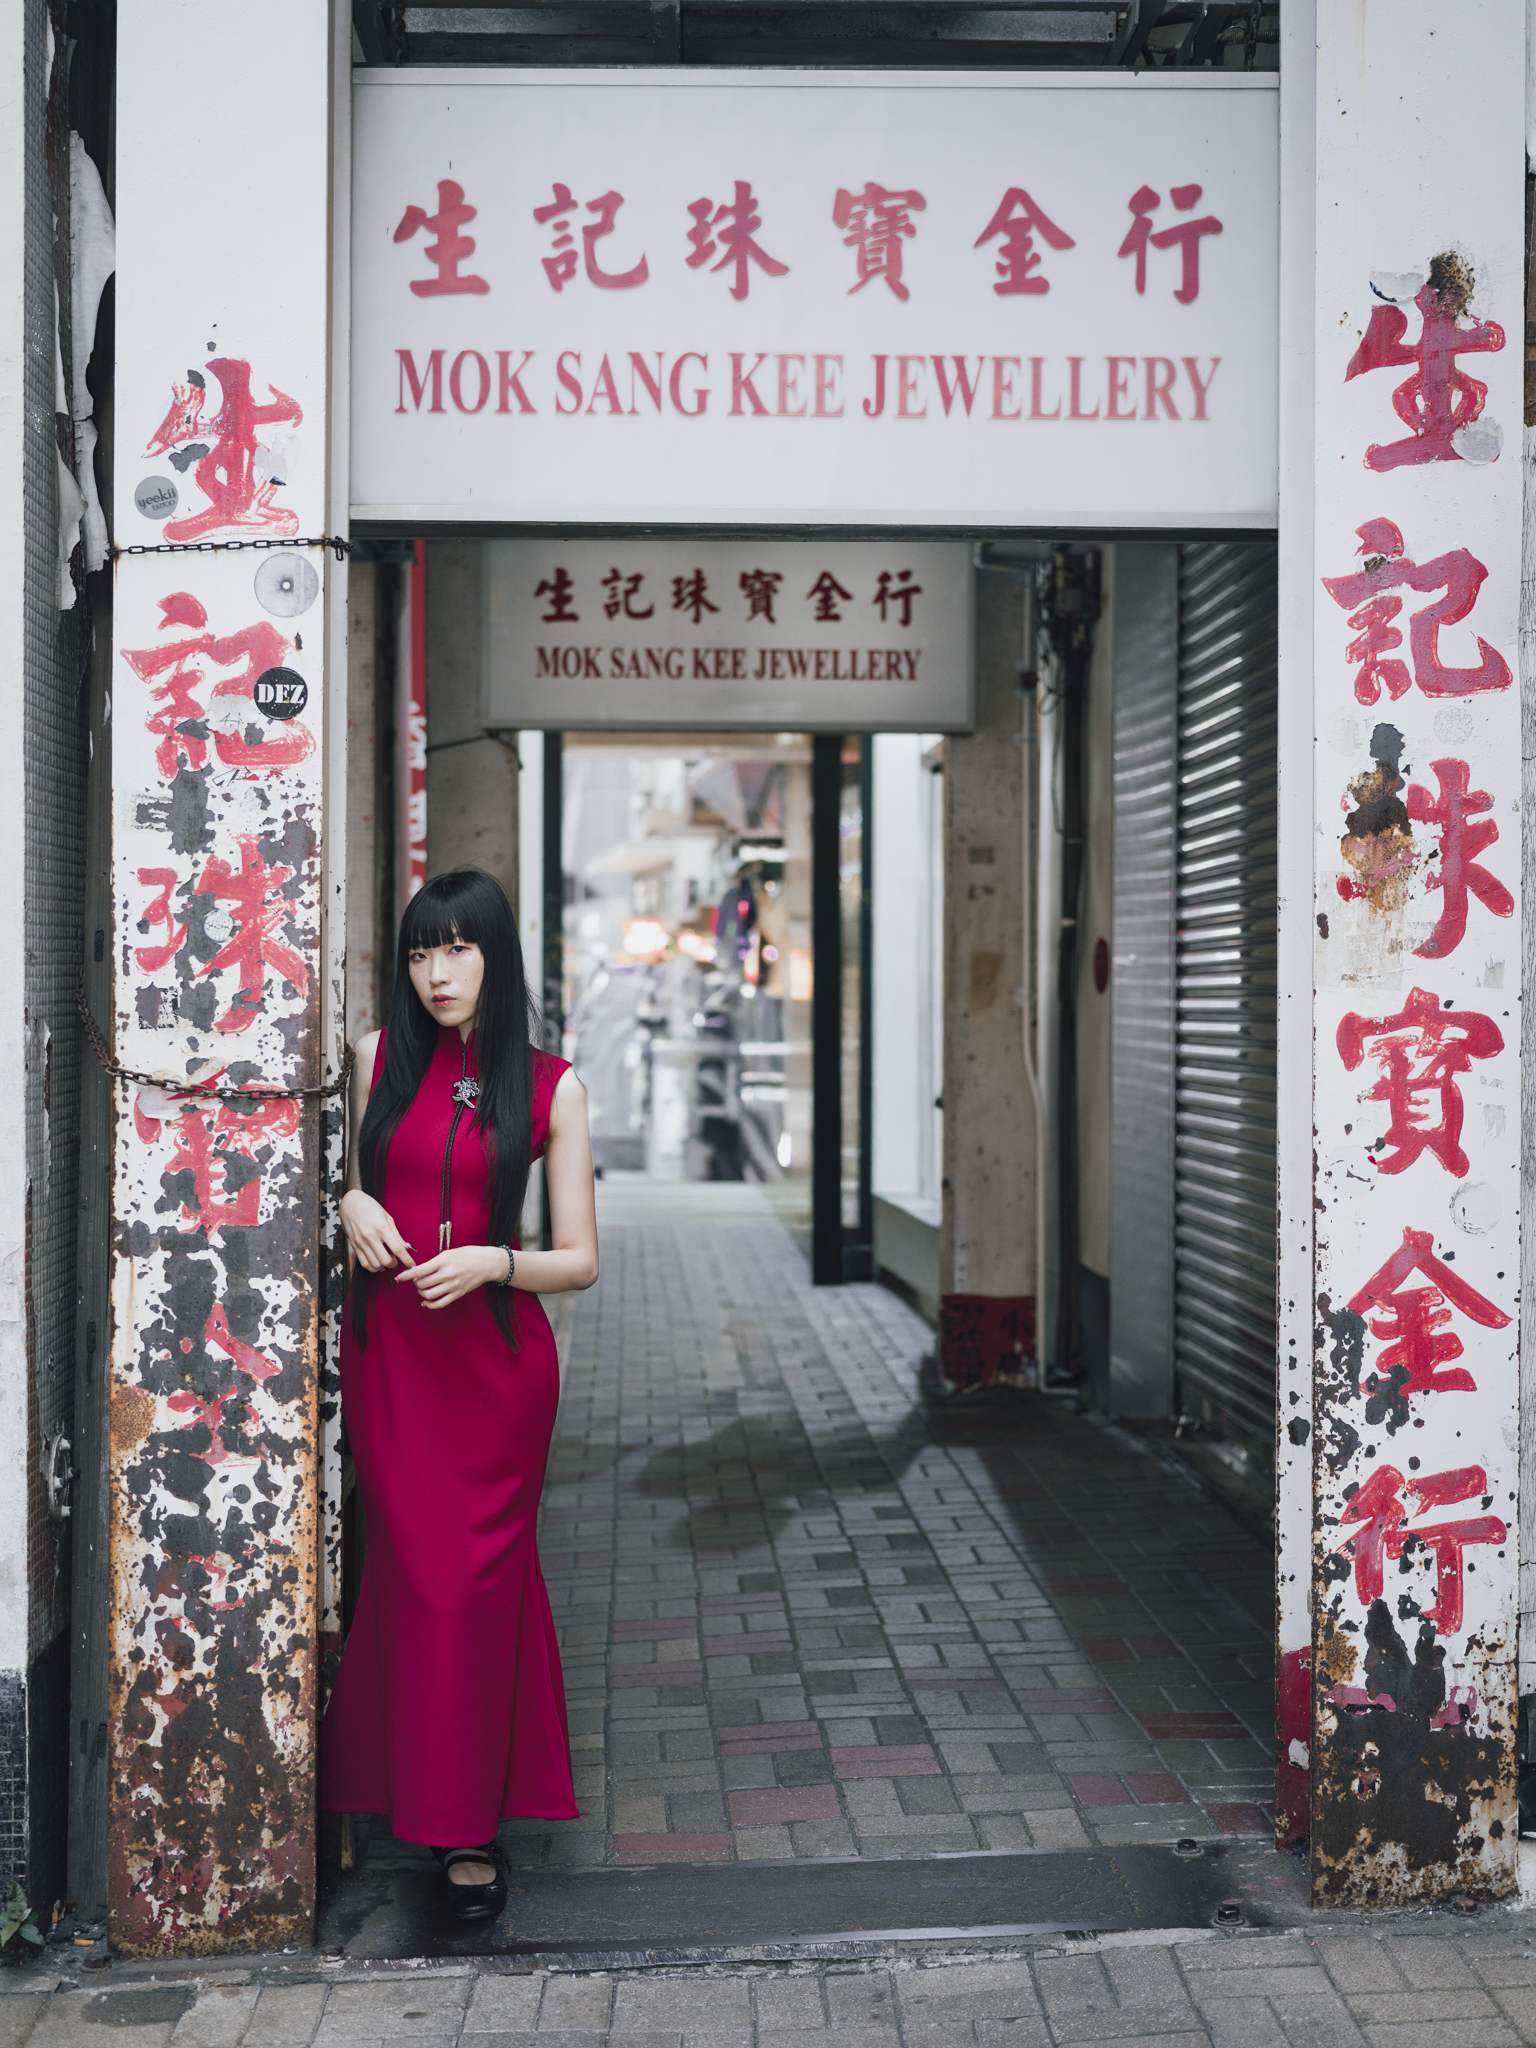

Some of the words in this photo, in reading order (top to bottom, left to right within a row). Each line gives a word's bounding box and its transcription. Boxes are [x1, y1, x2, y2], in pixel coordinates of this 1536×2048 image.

[393, 178, 1224, 305] 生記珠寶金行
[395, 349, 537, 415] MOK
[556, 351, 710, 417] SANG
[728, 353, 844, 418] KEE
[862, 354, 1221, 420] JEWELLERY
[534, 567, 923, 627] 生記珠寶金行
[257, 683, 305, 704] DEZ
[536, 646, 603, 680] MOK
[610, 647, 685, 680] SANG
[691, 648, 748, 681] KEE
[754, 649, 921, 682] JEWELLERY
